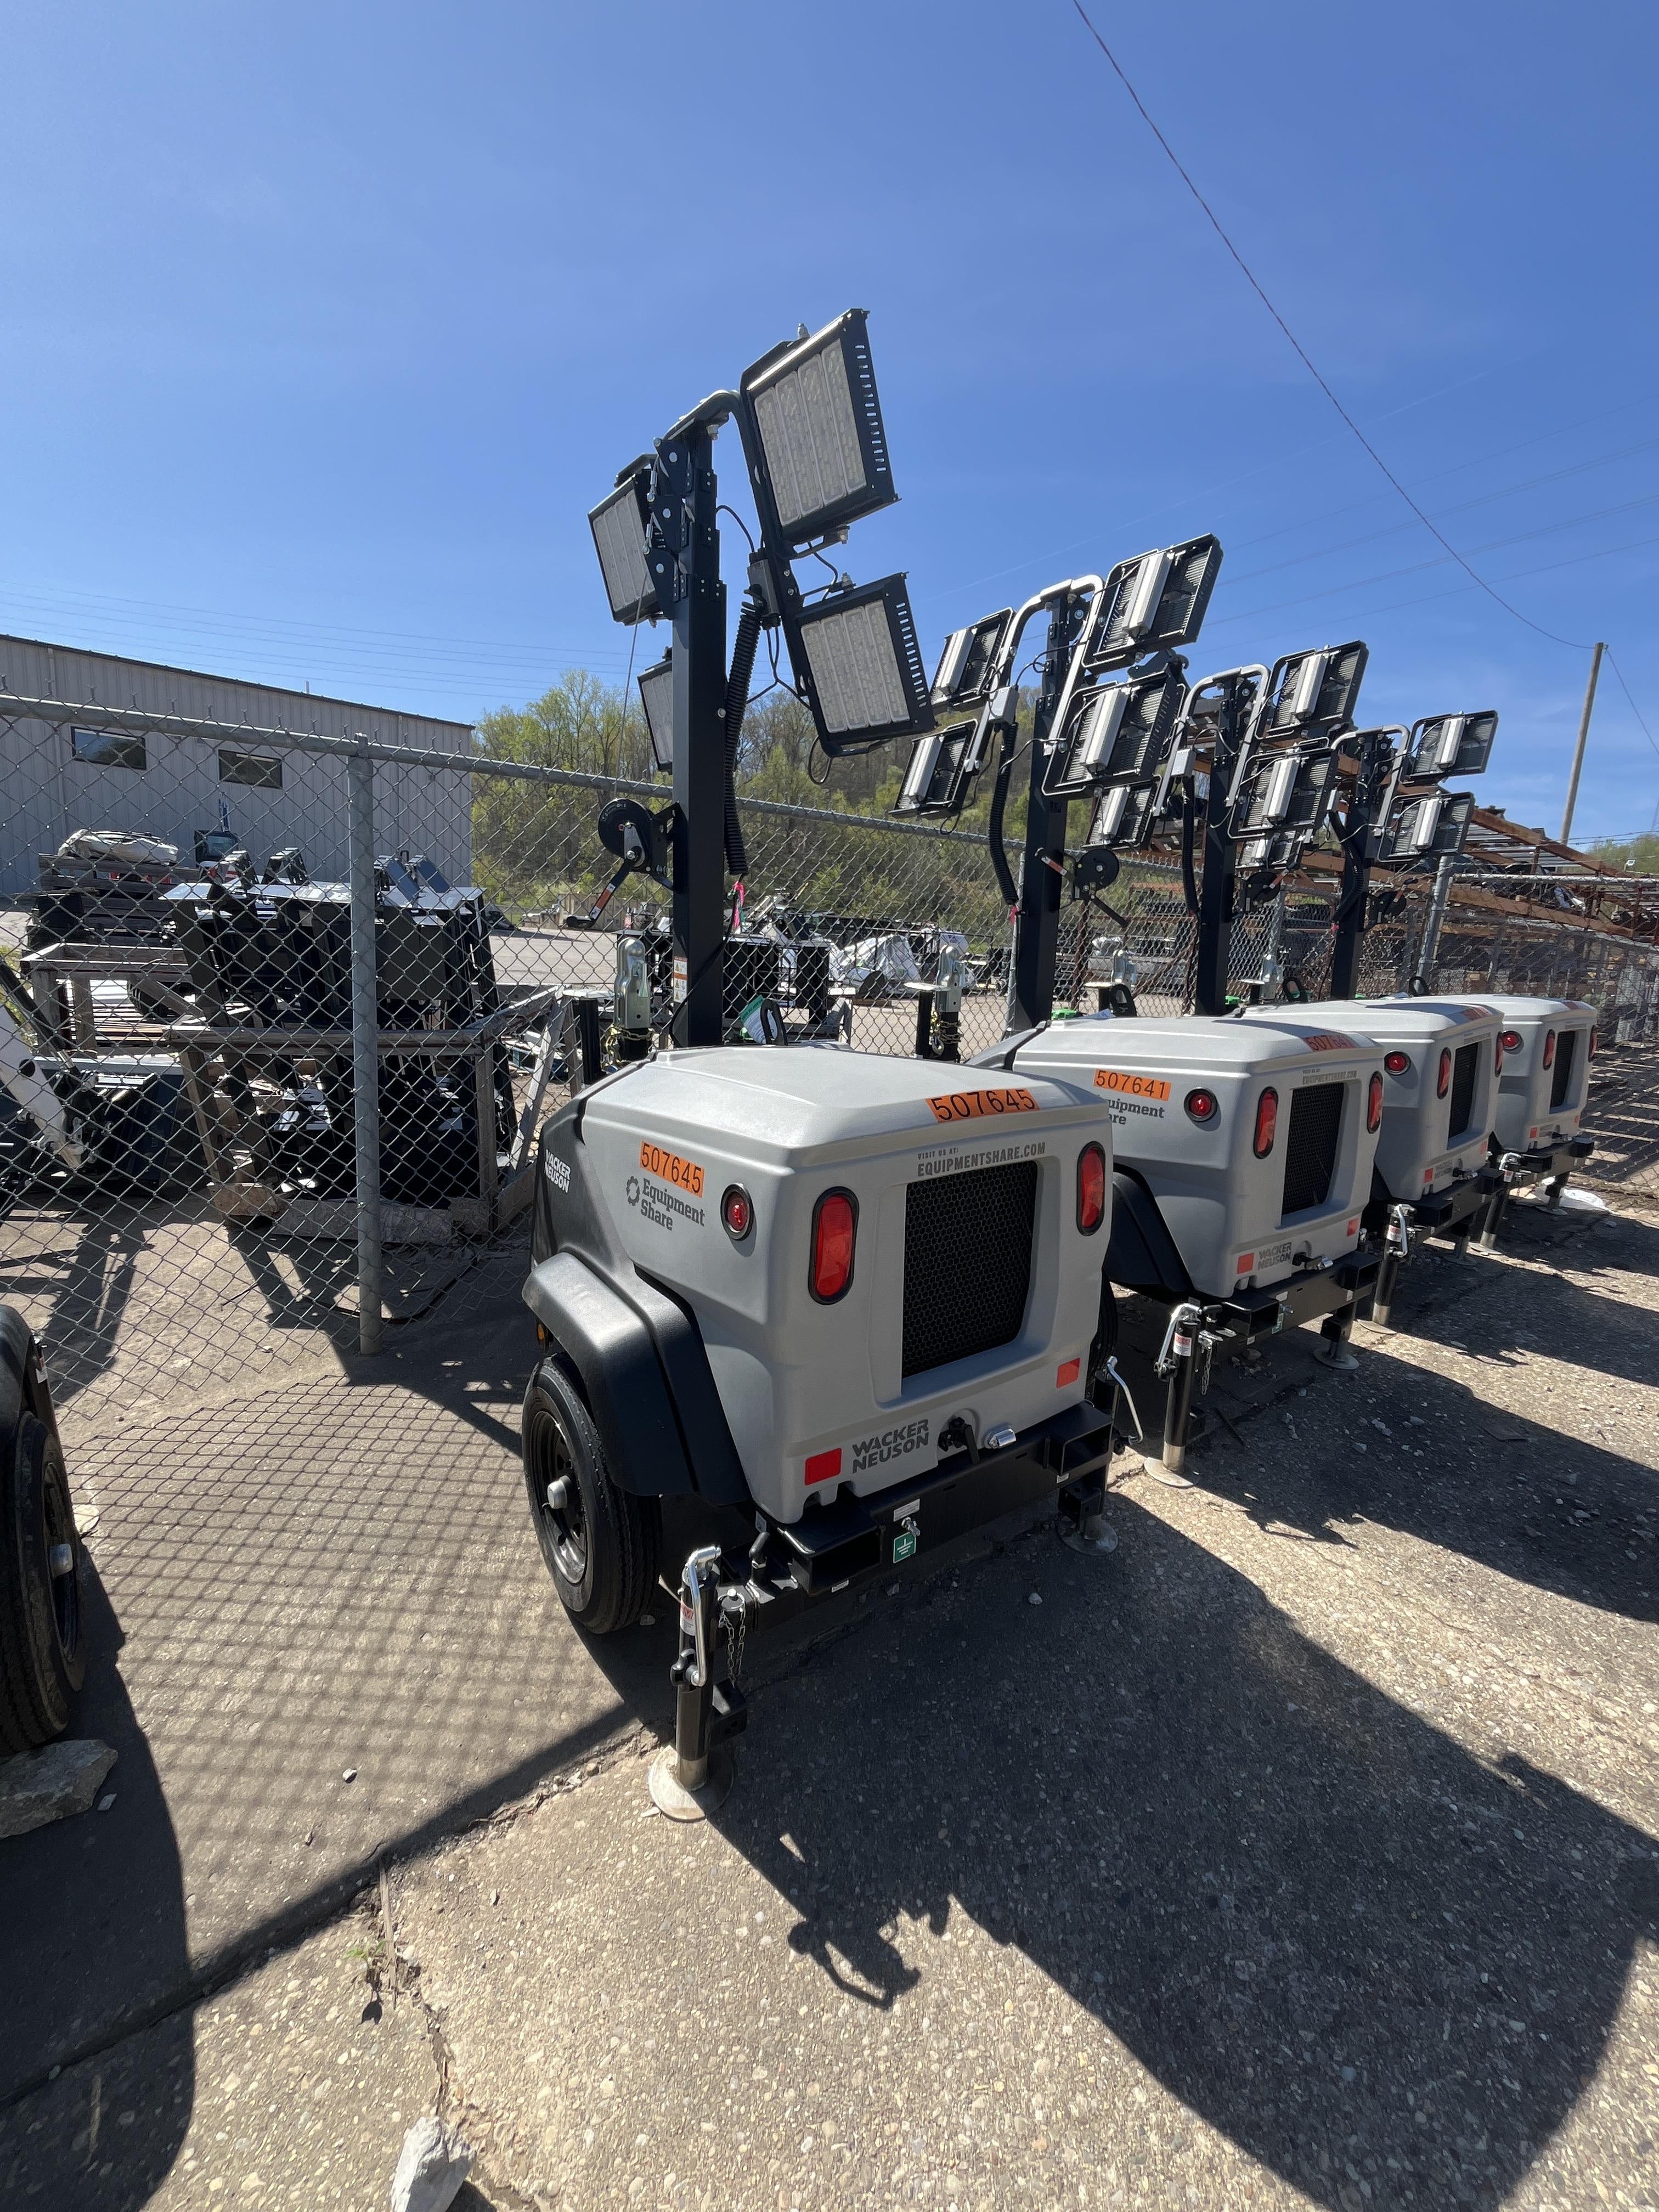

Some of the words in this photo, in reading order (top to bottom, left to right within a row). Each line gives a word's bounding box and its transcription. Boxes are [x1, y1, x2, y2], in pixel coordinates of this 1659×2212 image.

[1096, 1070, 1165, 1098] 507641
[931, 1089, 1035, 1121] 507645
[1106, 1098, 1165, 1118] uipment
[1108, 1113, 1126, 1125] are
[545, 1149, 571, 1181] WACKER
[641, 1142, 701, 1193] 507645
[917, 1142, 1046, 1177] EQUIPMENTSHARE.COM
[918, 1151, 935, 1160] VISIT
[544, 1161, 569, 1193] NEUSON
[641, 1198, 673, 1231] Share
[642, 1177, 705, 1227] Equipment
[852, 1419, 929, 1457] WACKER
[853, 1432, 929, 1474] NEUSON
